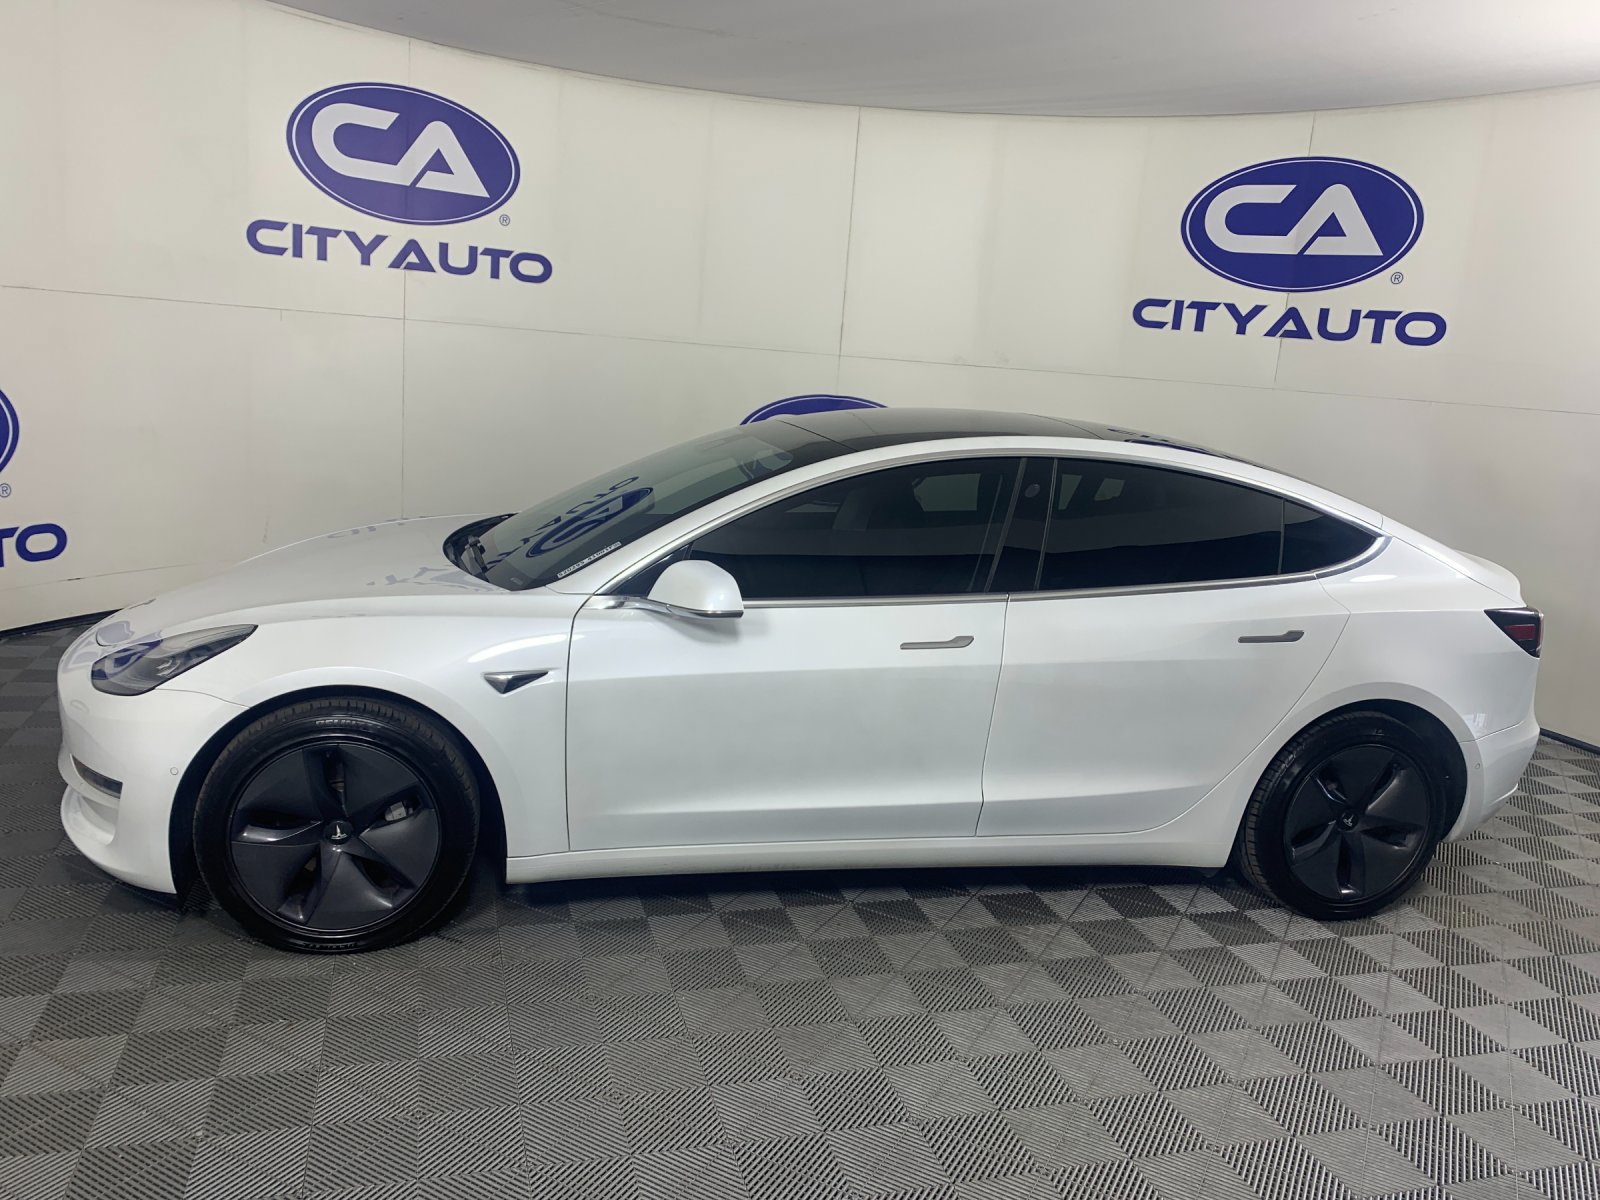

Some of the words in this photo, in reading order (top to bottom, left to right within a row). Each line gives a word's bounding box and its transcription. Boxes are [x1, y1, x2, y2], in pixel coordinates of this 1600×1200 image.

[311, 102, 491, 198] CA
[246, 219, 389, 266] CITY
[387, 238, 553, 284] AUTO
[1204, 183, 1384, 256] CA
[1132, 297, 1268, 335] CITY
[1263, 306, 1447, 346] AUTO
